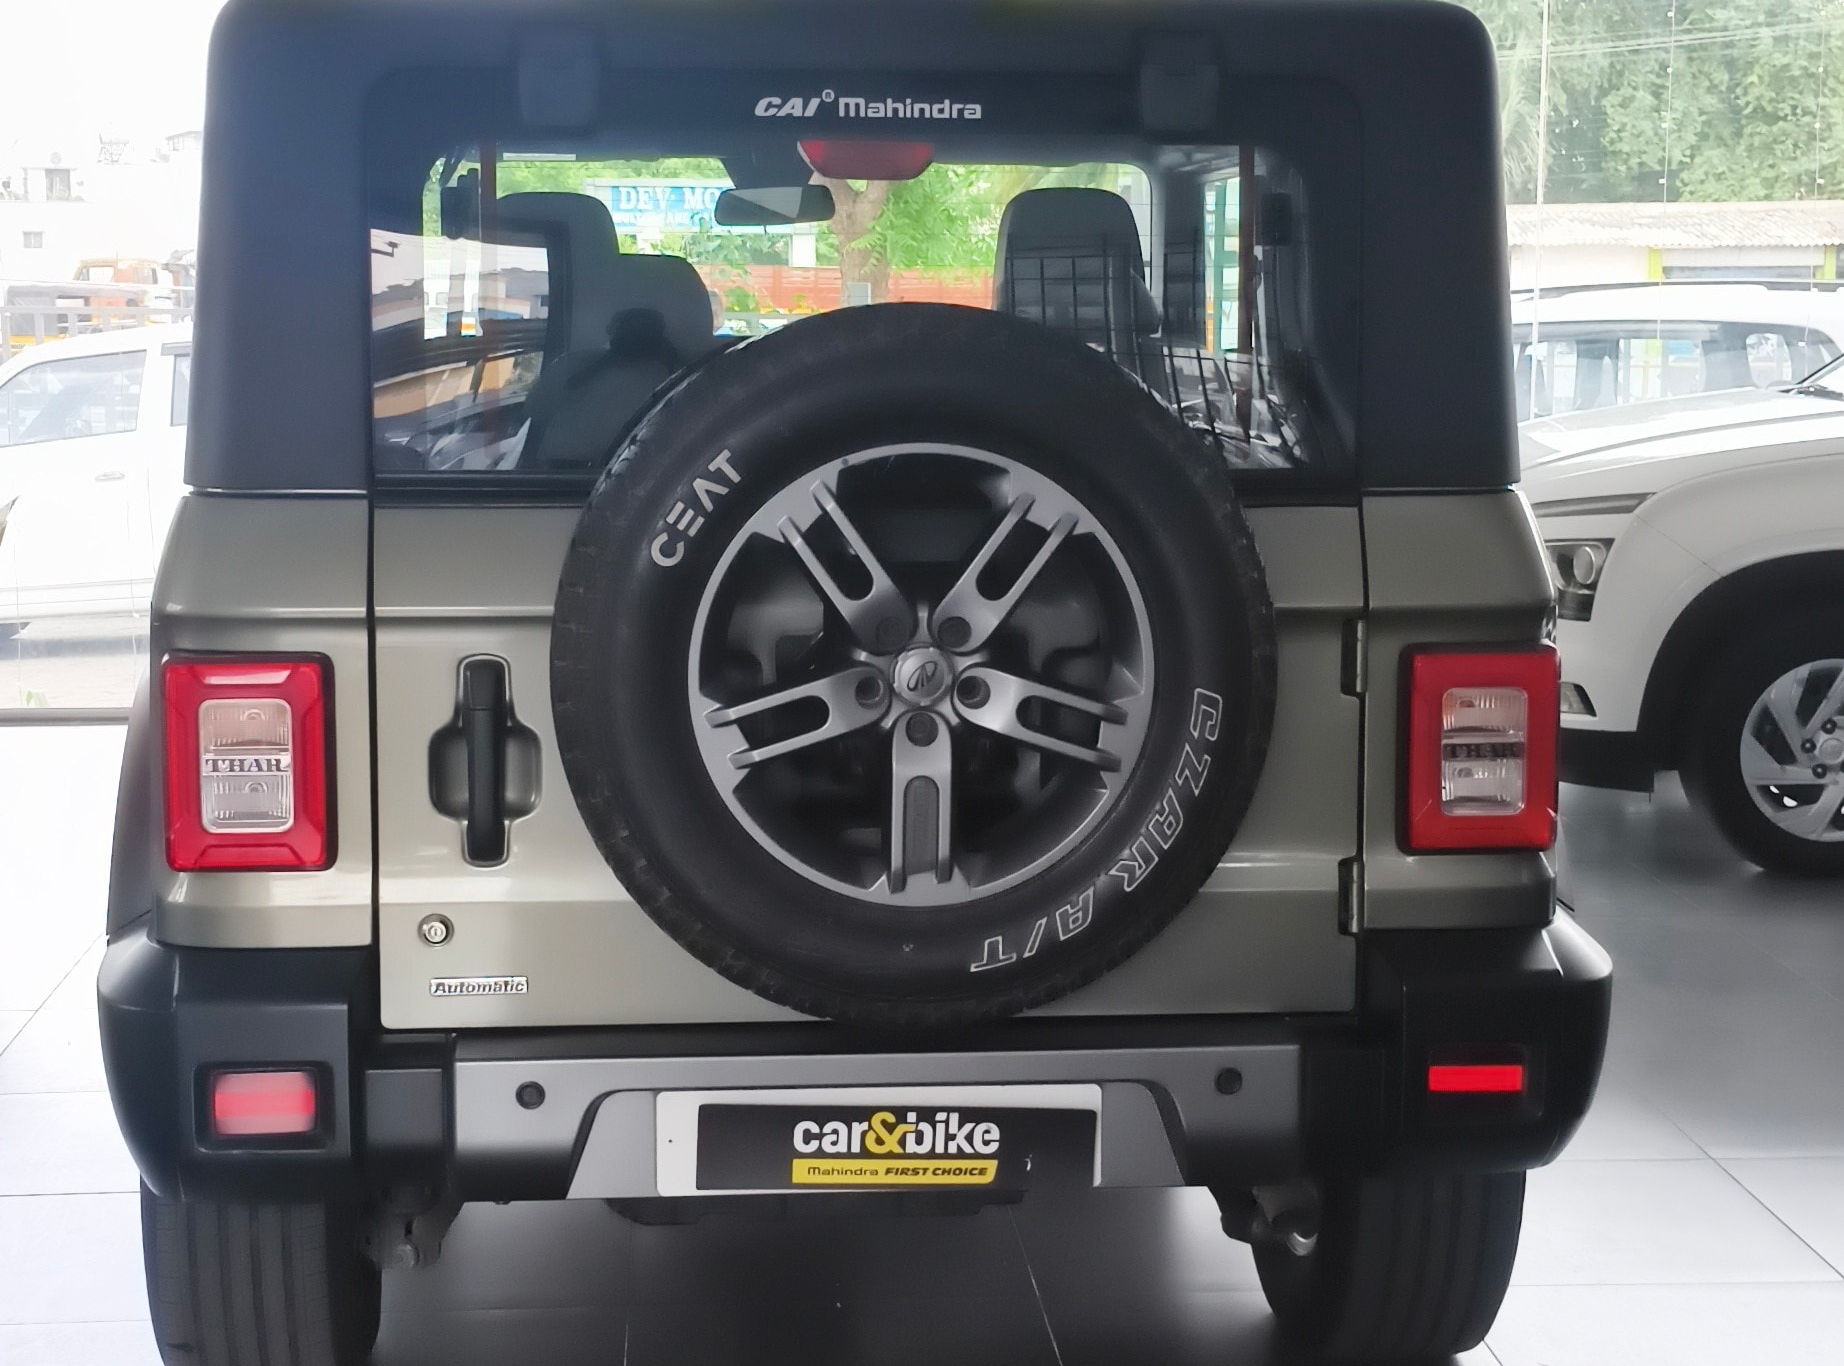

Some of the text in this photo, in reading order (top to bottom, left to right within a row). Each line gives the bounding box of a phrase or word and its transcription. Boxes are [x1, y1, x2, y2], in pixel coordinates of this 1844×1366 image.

[838, 97, 982, 119] Mahindra
[618, 187, 672, 210] DEV
[650, 448, 742, 567] CEAT
[205, 758, 289, 773] THAR
[969, 687, 1223, 973] CZAR A/T
[433, 980, 525, 994] Automatic
[792, 1110, 1001, 1154] car&bike
[807, 1166, 988, 1176] Mahindra FIRST CHOICE
